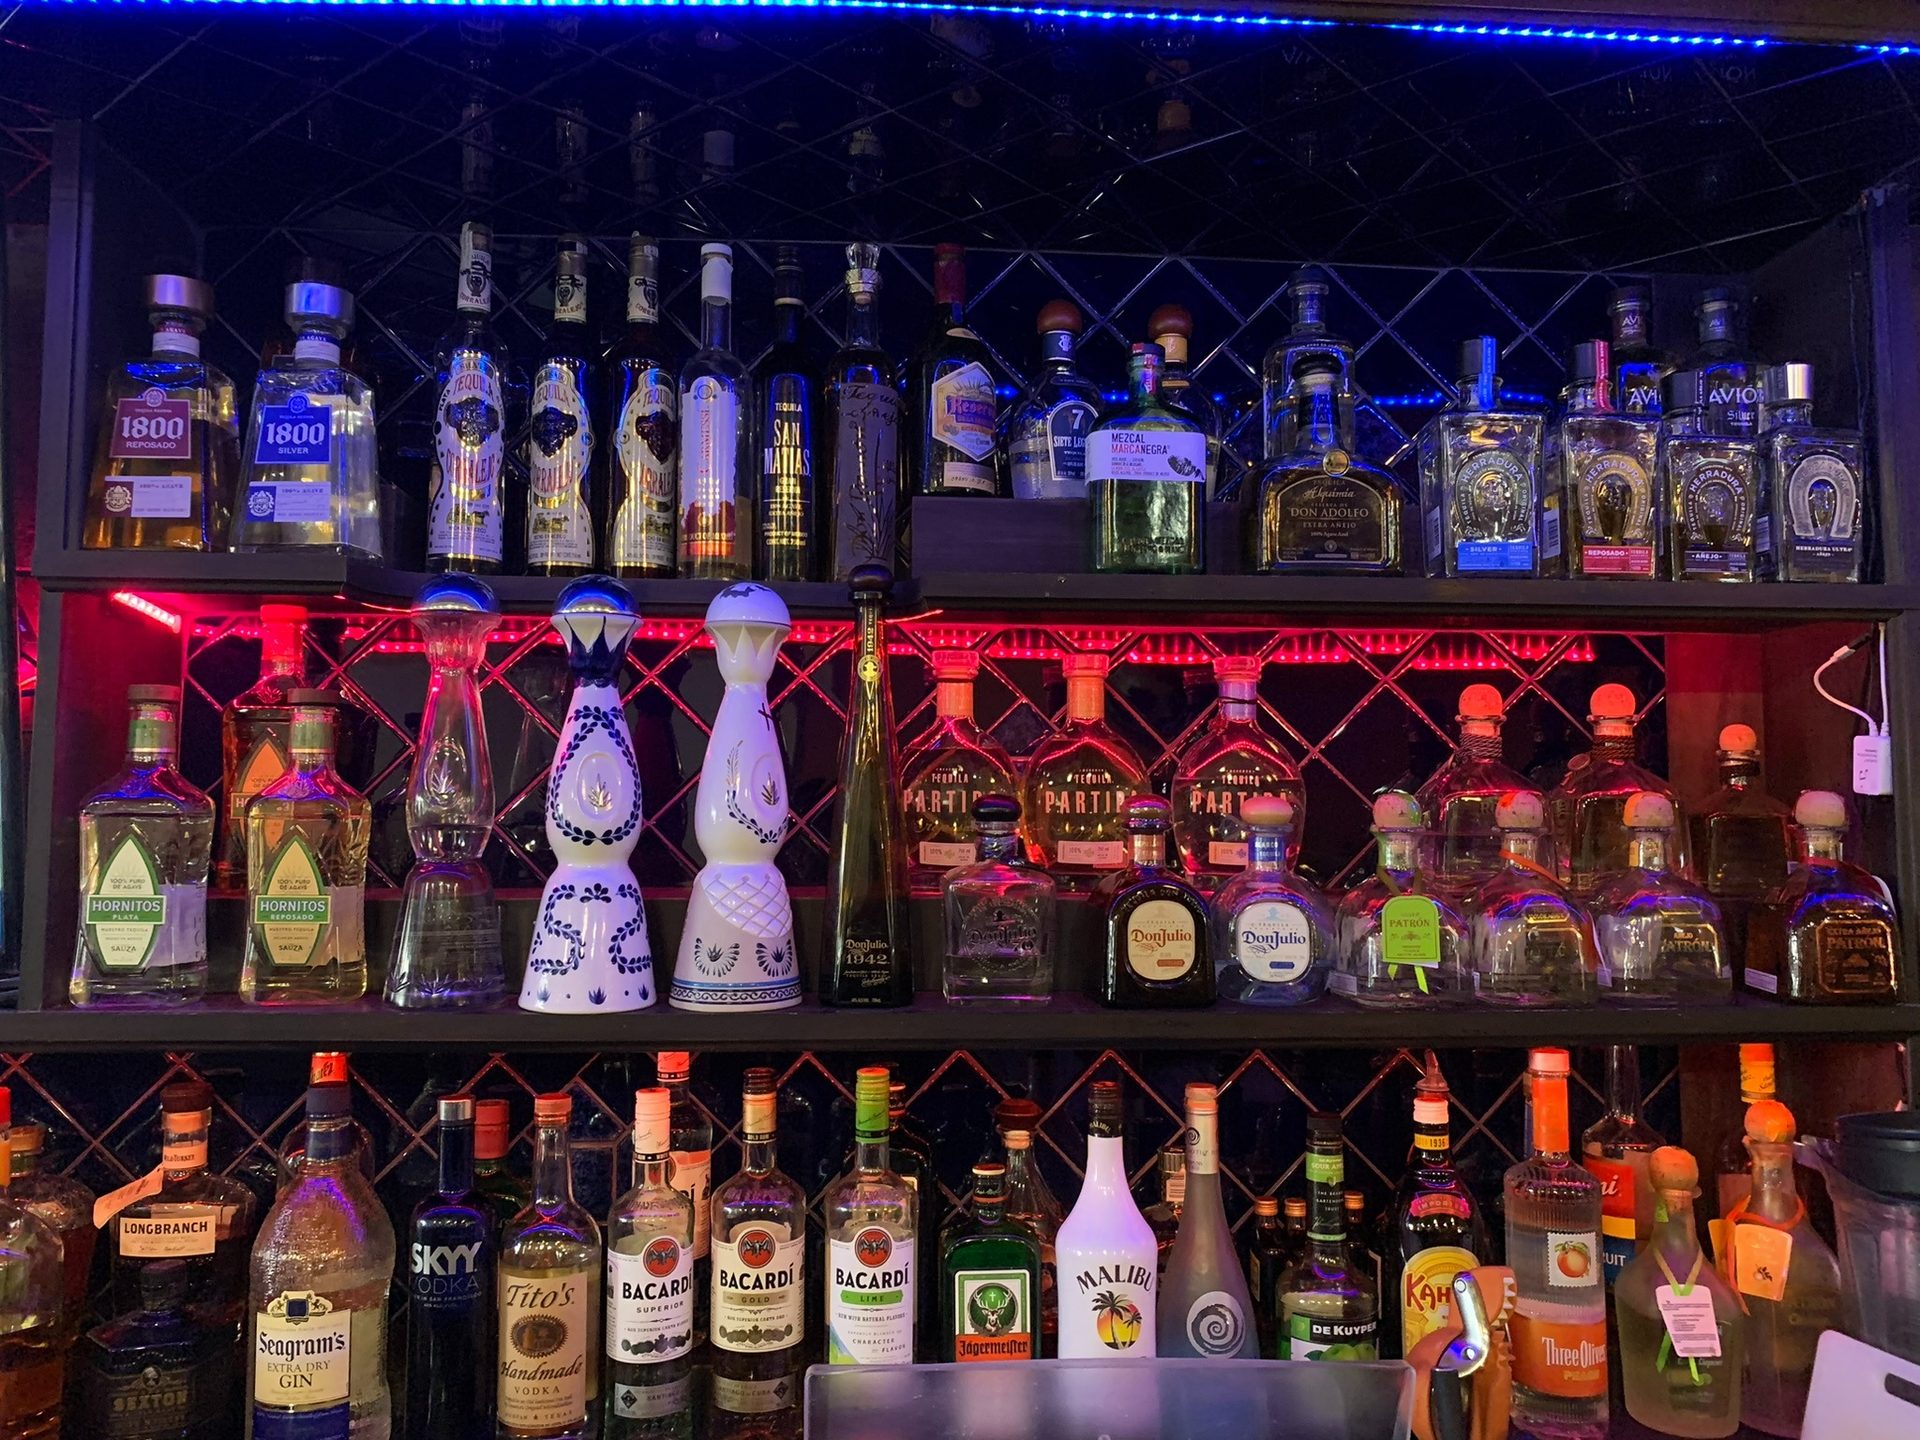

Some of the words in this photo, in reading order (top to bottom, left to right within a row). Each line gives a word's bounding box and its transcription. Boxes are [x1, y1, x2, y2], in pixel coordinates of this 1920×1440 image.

[1628, 388, 1660, 406] AVI
[775, 402, 802, 412] TEQUILA
[1727, 410, 1755, 420] Silver
[1072, 409, 1084, 430] 7
[121, 416, 184, 440] 1800
[266, 422, 325, 445] 1800
[774, 419, 800, 446] SAN
[126, 441, 177, 449] REPOSADO
[1053, 435, 1072, 448] SIETE
[1111, 433, 1145, 443] MEZCAL
[1111, 443, 1168, 455] MARCANEGRA
[764, 447, 809, 476] MATIAS
[1461, 457, 1523, 482] HERRADURA
[1585, 460, 1643, 486] HERRADURA
[1690, 470, 1744, 494] HERRADURA
[1302, 486, 1356, 502] Alquimia
[1290, 507, 1318, 517] DON
[1321, 508, 1369, 518] ADOLFO
[931, 773, 969, 784] TEQUILA
[1074, 774, 1114, 784] TEQUILA
[1222, 775, 1261, 786] TEQUILA
[903, 790, 998, 813] PARTI
[92, 900, 160, 912] HORNITOS
[260, 900, 326, 912] HORNITOS
[1390, 918, 1430, 927] PATRÓN
[1131, 929, 1192, 948] DonJulio
[1242, 931, 1306, 949] DonJulio
[111, 945, 137, 953] SAUZA
[845, 954, 889, 965] 1942
[124, 1221, 208, 1234] LONGBRANCH
[412, 1241, 482, 1275] SKYY
[720, 1262, 794, 1291] BACARDÍ
[836, 1262, 910, 1289] BACARDÍ
[1076, 1264, 1151, 1294] MALIBU
[622, 1269, 693, 1301] BACARDÍ
[1406, 1273, 1451, 1312] KAH
[506, 1282, 576, 1308] Tito's
[741, 1296, 770, 1304] GOLD
[636, 1301, 684, 1314] SUPERIOR
[1312, 1324, 1331, 1335] DE
[259, 1331, 346, 1362] Seagram's
[1541, 1336, 1579, 1367] Three
[267, 1362, 301, 1373] EXTRA
[306, 1361, 331, 1372] DRY
[500, 1354, 583, 1381] Handmade
[279, 1374, 313, 1389] GIN
[514, 1386, 560, 1395] VODKA
